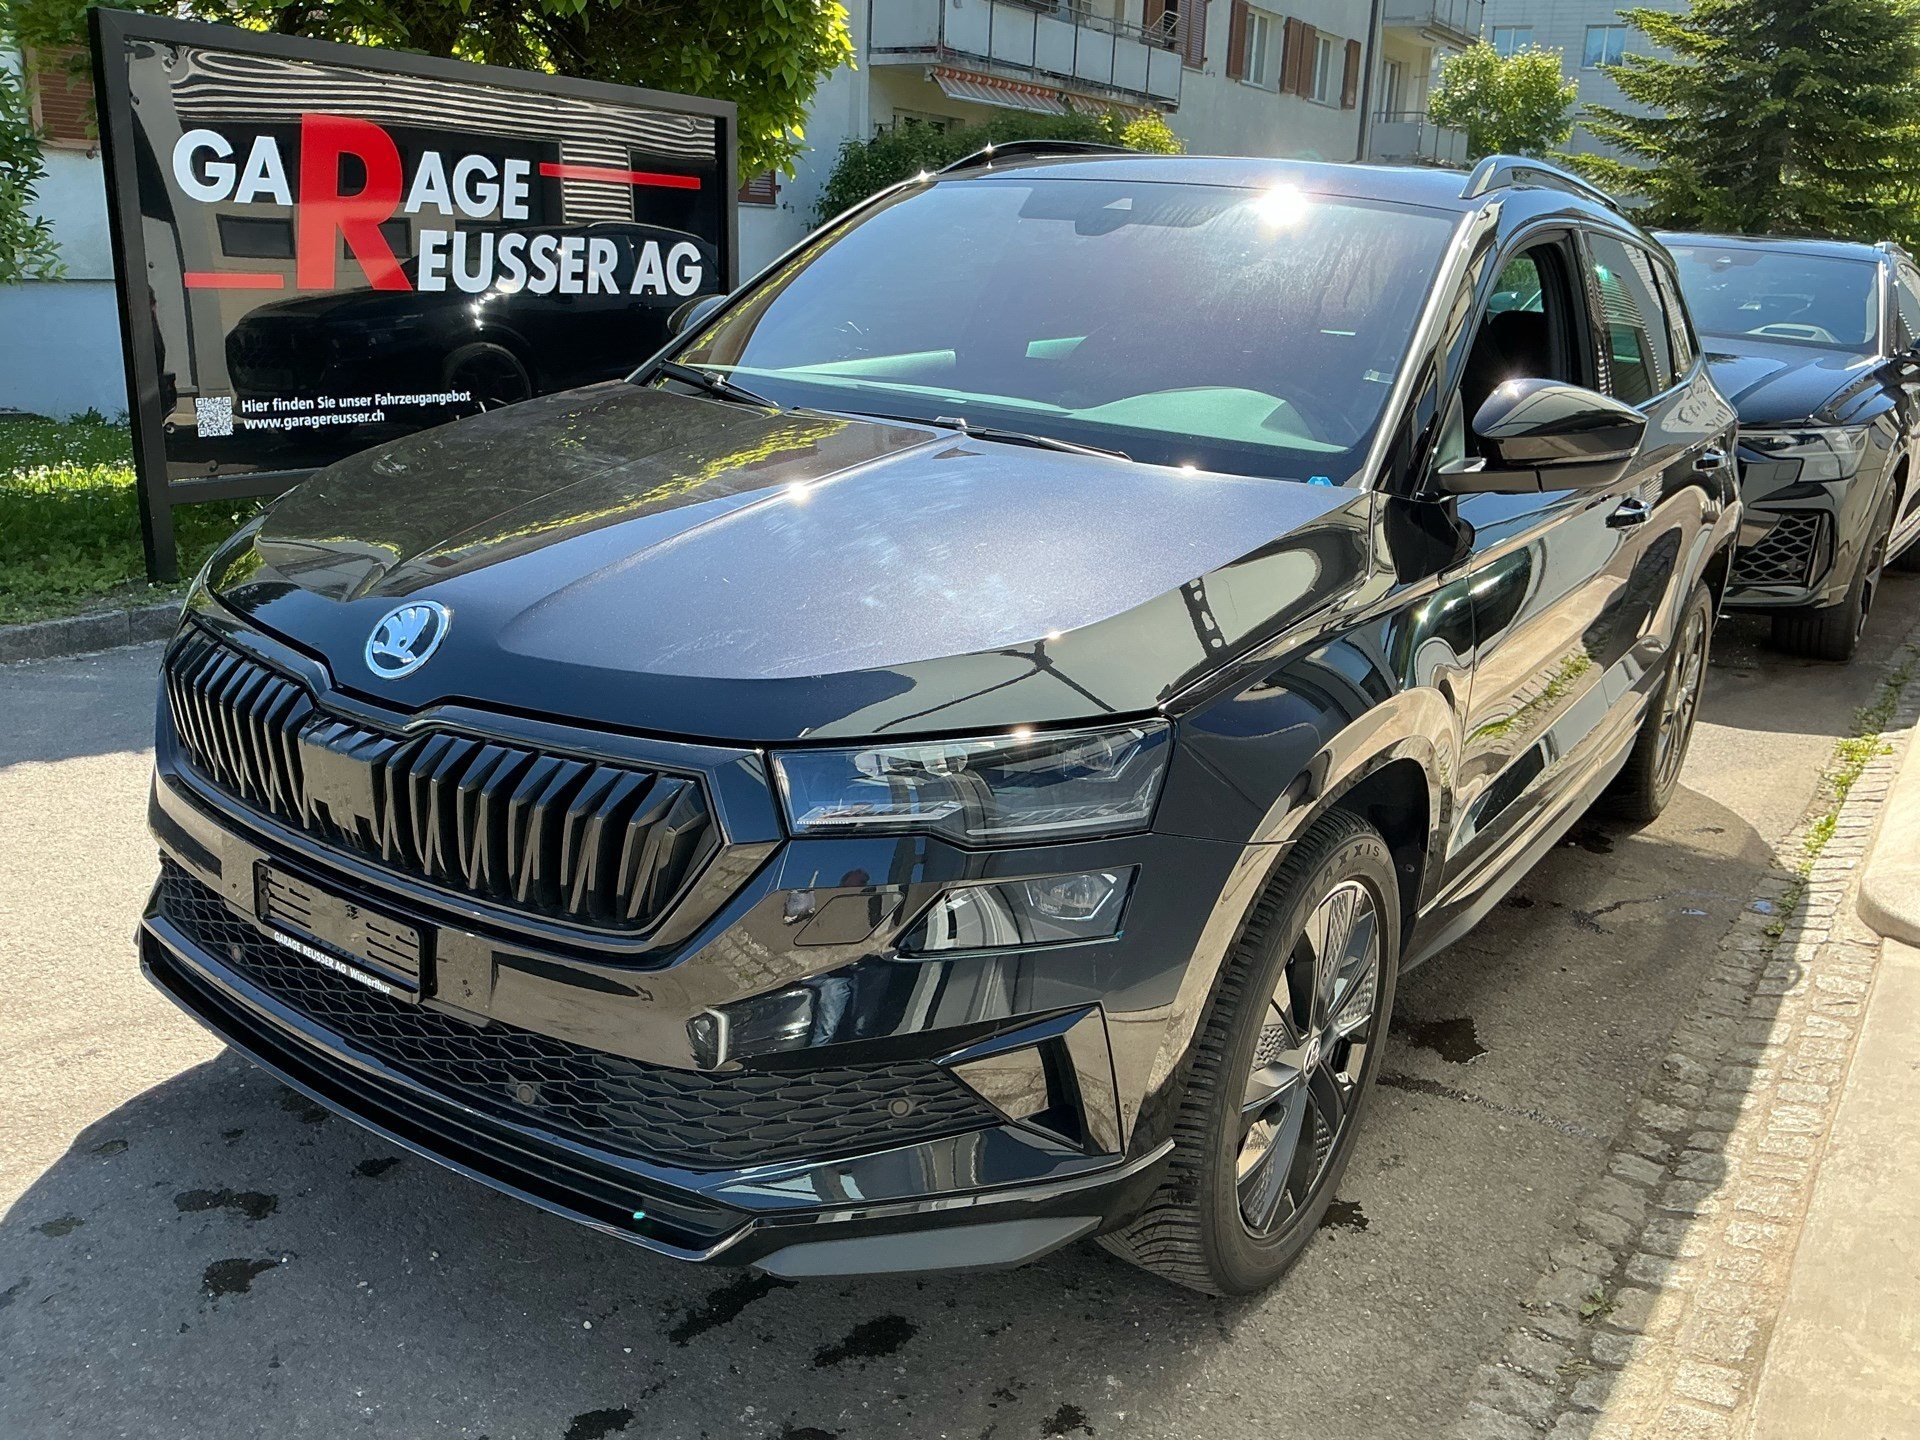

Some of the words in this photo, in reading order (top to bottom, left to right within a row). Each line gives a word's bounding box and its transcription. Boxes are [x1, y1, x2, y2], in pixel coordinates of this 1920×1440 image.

[172, 113, 531, 292] GARAGE
[630, 241, 703, 296] AG
[242, 399, 269, 413] Hier
[273, 397, 312, 411] finden
[317, 396, 336, 408] Sie
[339, 396, 372, 408] unser
[374, 390, 471, 406] Fahrzeugangebot
[244, 409, 385, 430] www.garagereusser.ch
[1304, 843, 1380, 912] MAXXIS
[274, 931, 302, 952] GARAGE
[302, 945, 335, 970] REUSSER
[334, 961, 347, 974] AG
[350, 967, 391, 994] Winterthur
